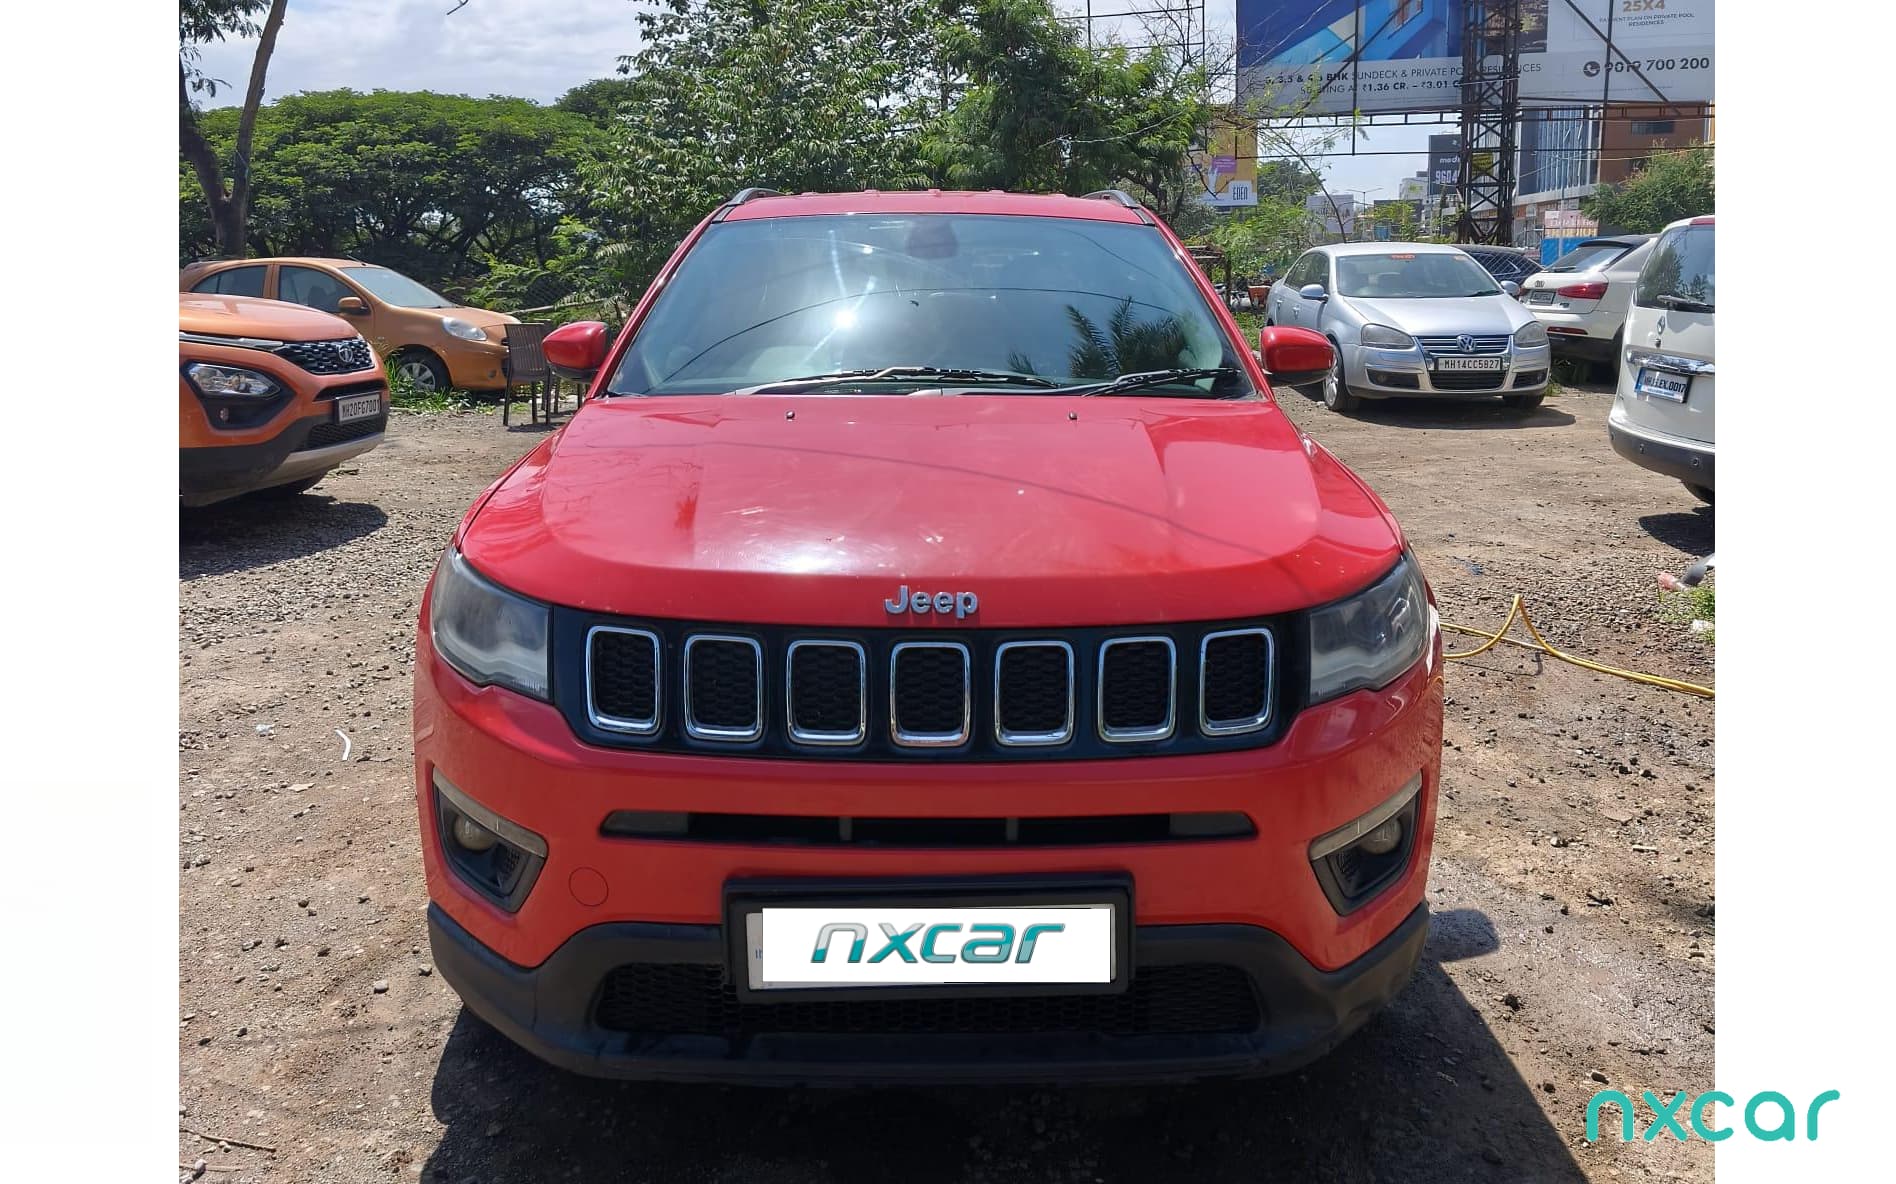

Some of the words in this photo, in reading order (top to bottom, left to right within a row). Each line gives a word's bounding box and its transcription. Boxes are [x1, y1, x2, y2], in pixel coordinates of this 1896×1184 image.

[1623, 0, 1665, 12] 25X4
[1646, 59, 1676, 71] 700
[1680, 57, 1710, 70] 200
[1401, 68, 1408, 78] &
[1411, 67, 1447, 78] PRIVATE
[1444, 359, 1500, 369] MH14CC5827
[884, 585, 978, 619] Jeep
